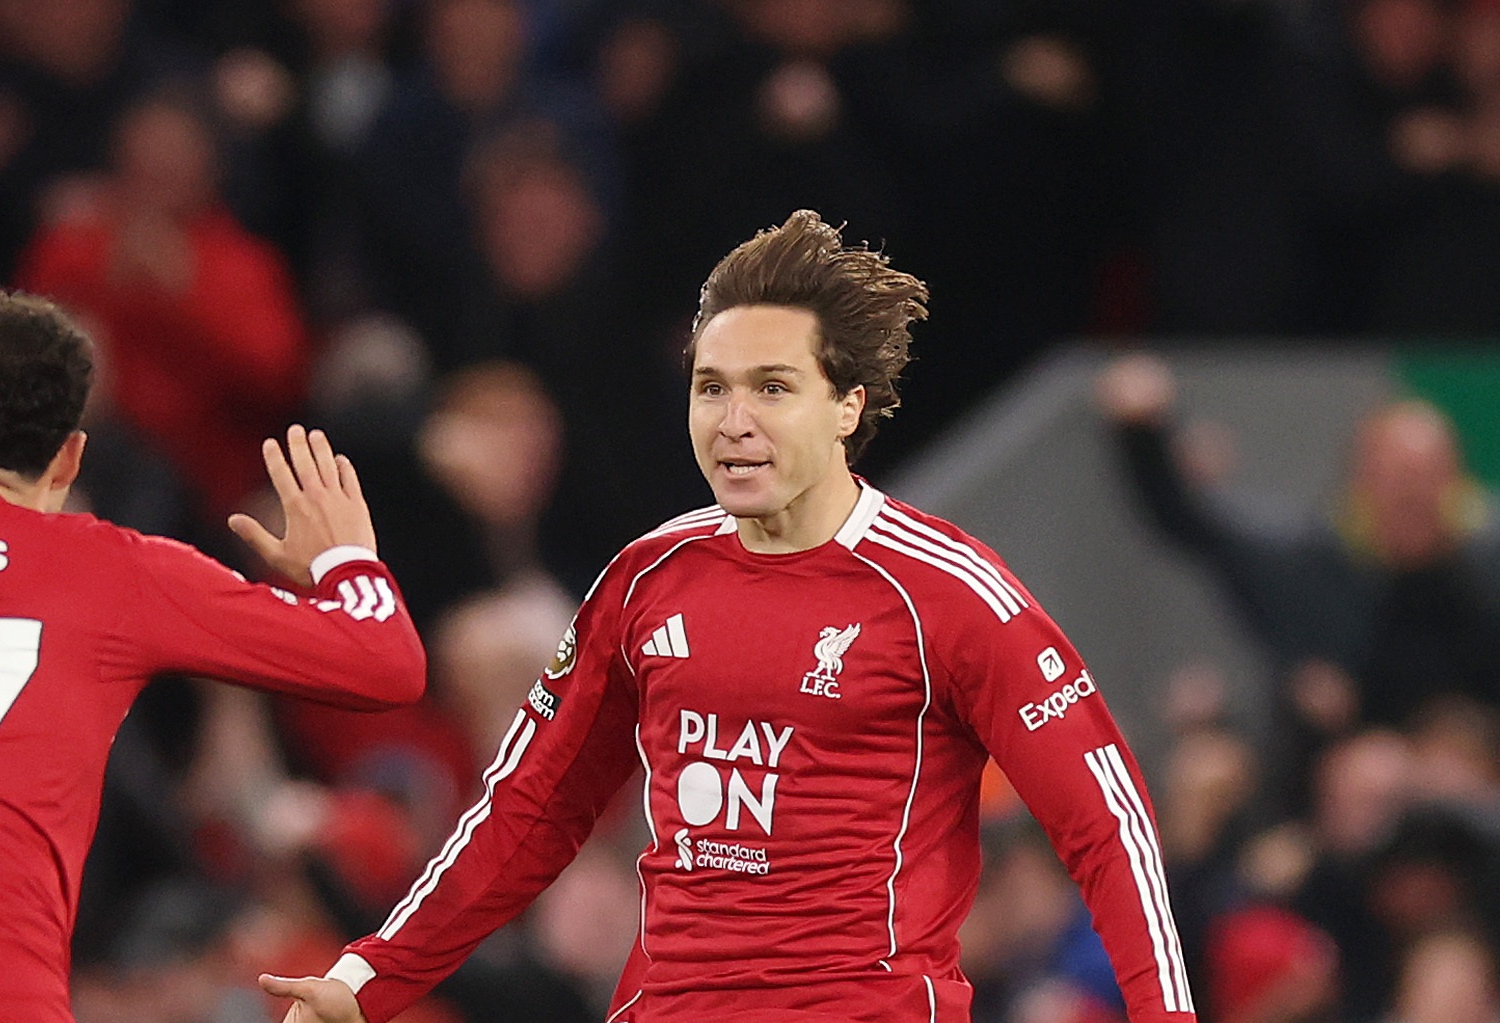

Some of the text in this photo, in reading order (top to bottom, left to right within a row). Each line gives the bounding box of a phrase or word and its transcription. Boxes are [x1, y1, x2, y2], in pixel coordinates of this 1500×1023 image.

[678, 709, 794, 768] PLAY
[678, 761, 779, 836] ON
[696, 838, 767, 862] standard
[696, 852, 770, 875] chartered
